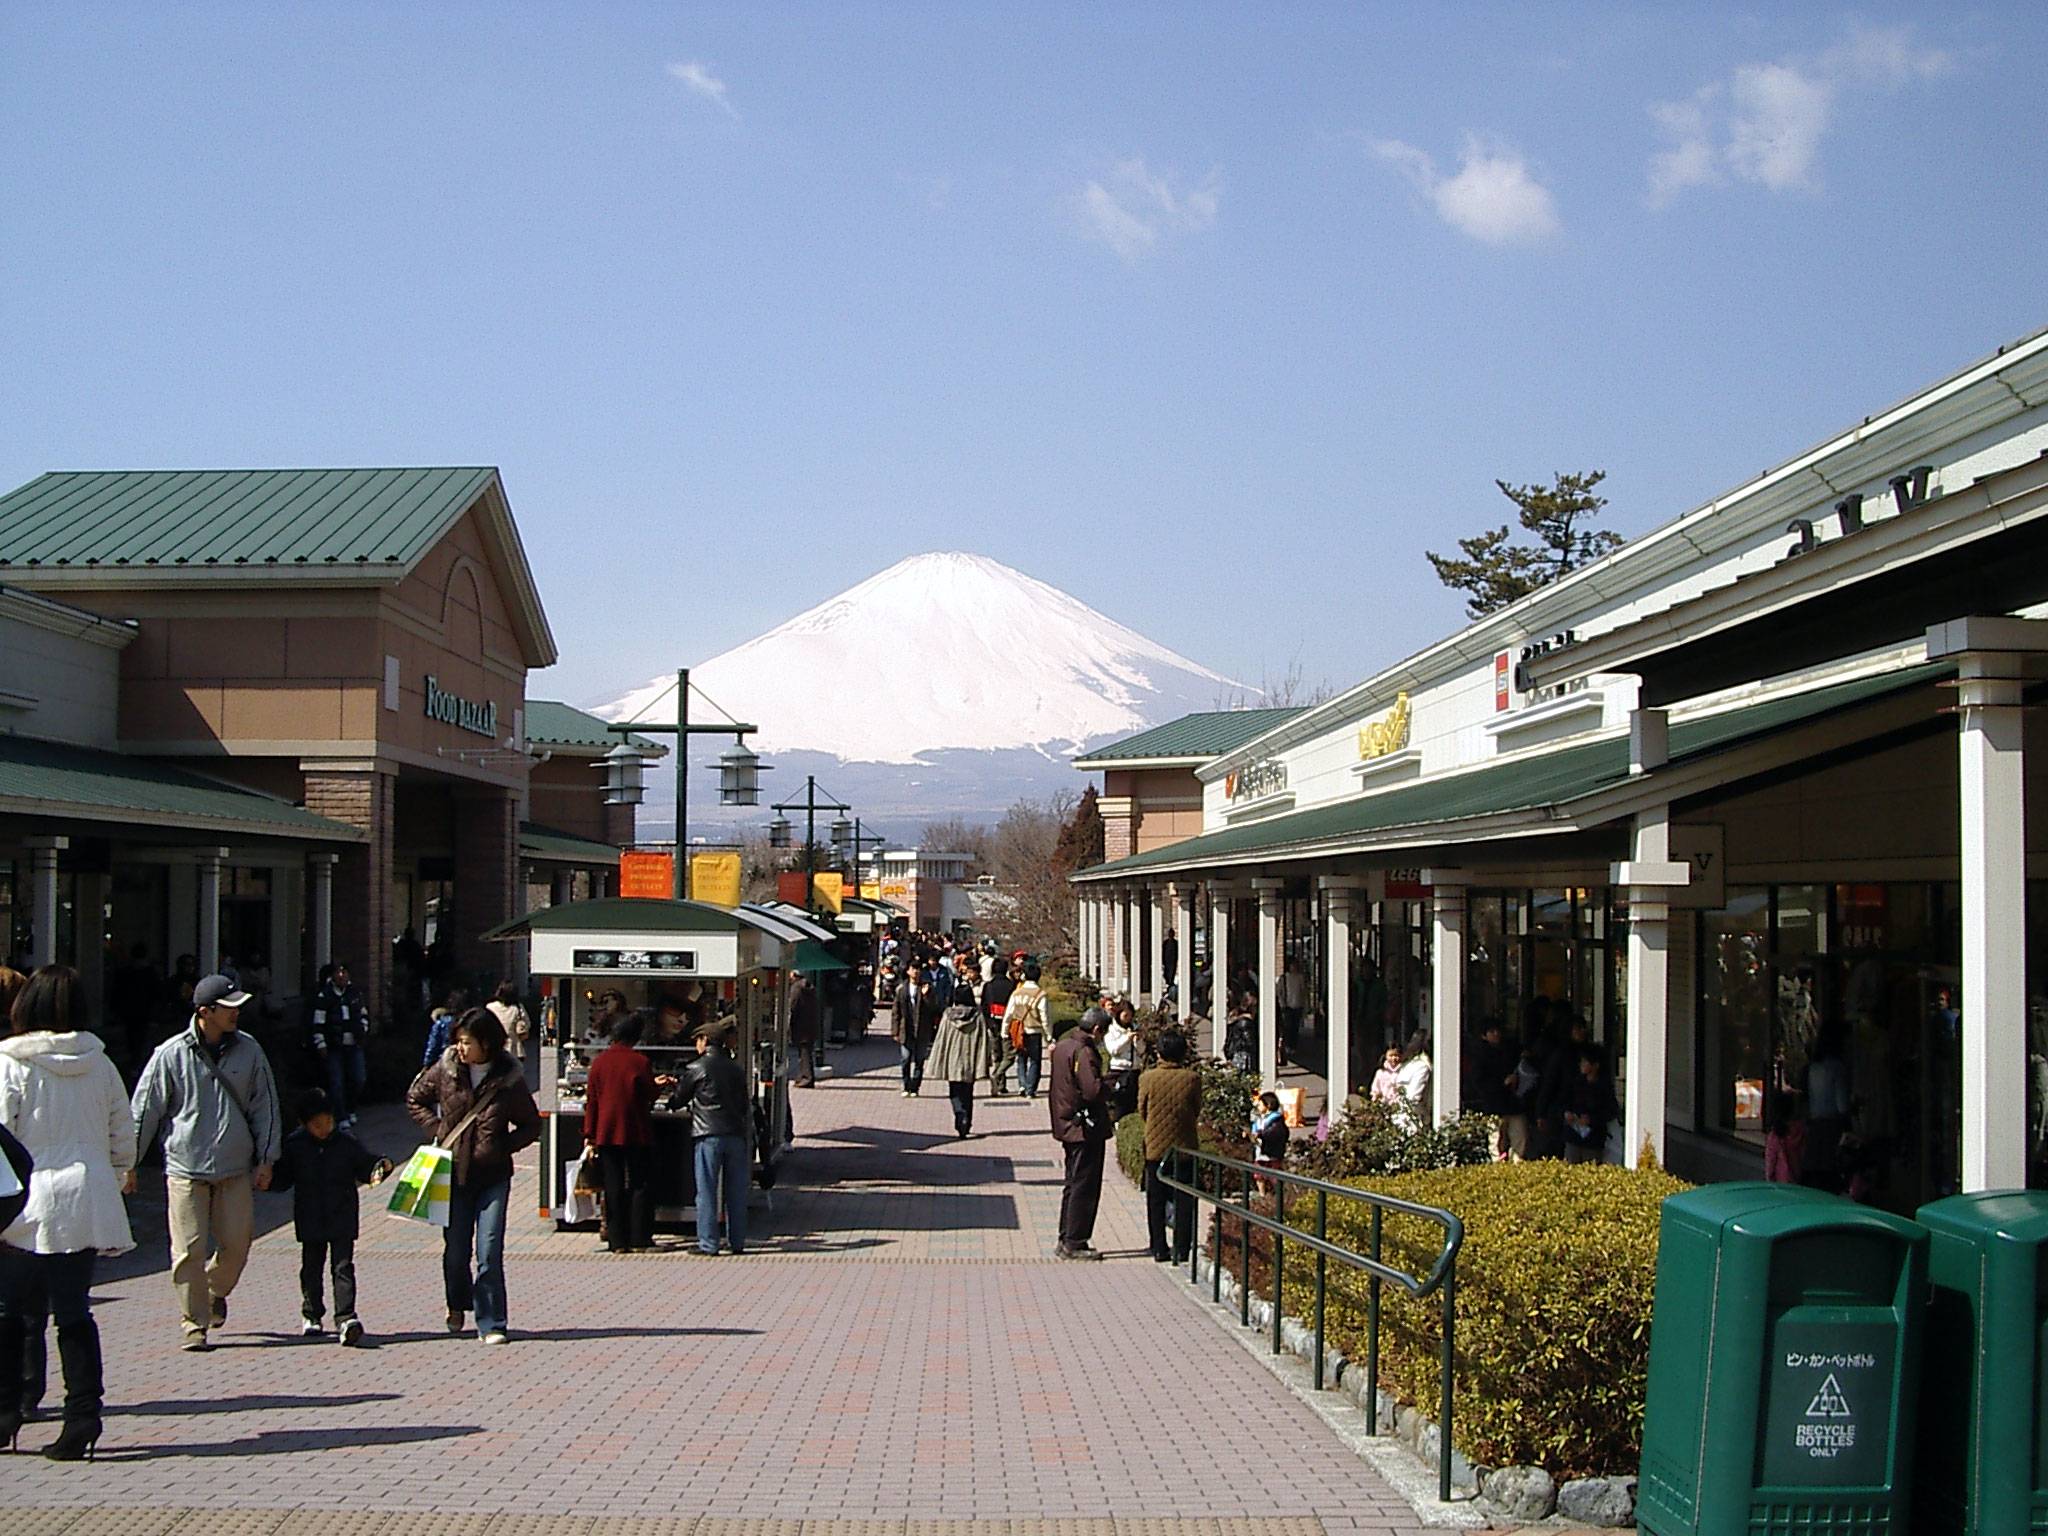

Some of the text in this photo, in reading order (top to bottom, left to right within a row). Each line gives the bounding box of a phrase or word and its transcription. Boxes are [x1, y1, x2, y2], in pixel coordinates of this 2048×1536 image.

[1796, 1424, 1855, 1436] RECYCLE
[1795, 1436, 1854, 1446] BOTTLES
[1809, 1447, 1839, 1457] ONLY
